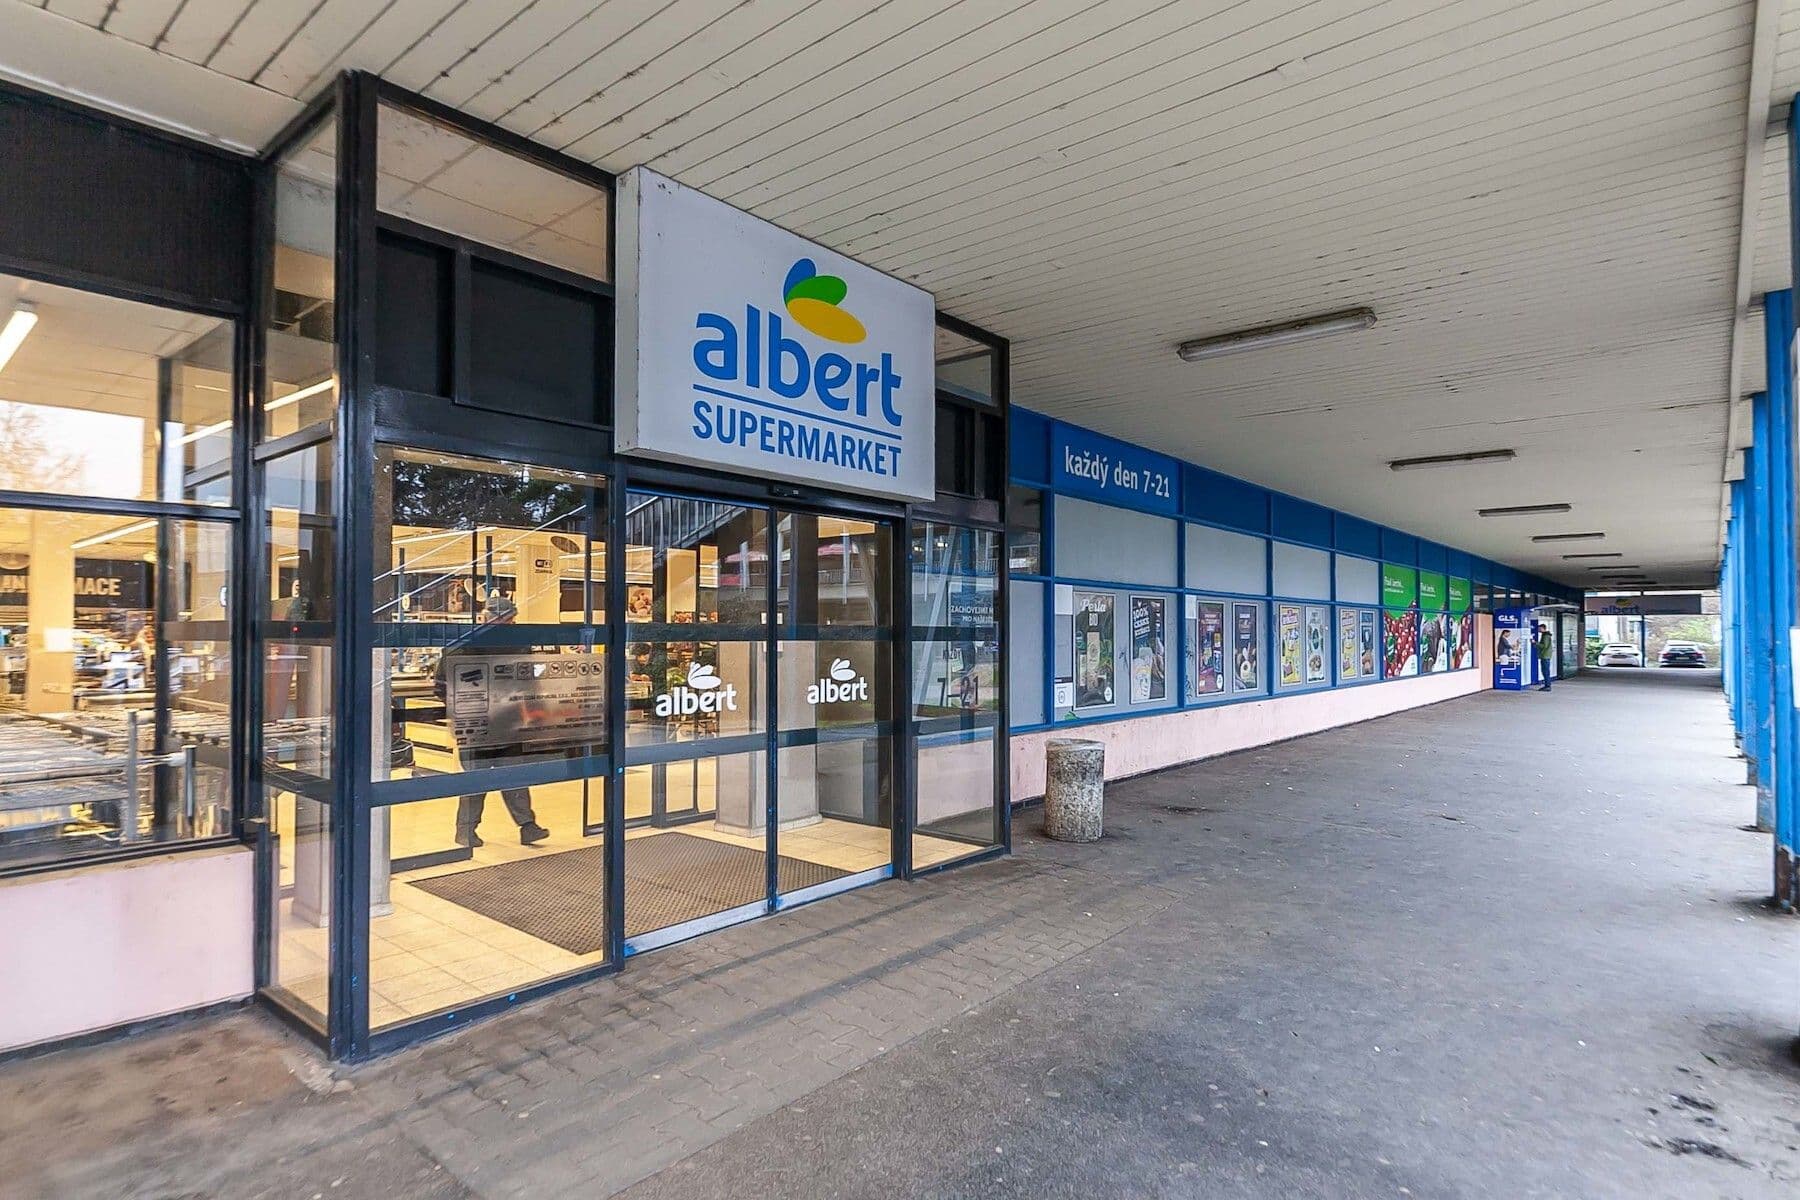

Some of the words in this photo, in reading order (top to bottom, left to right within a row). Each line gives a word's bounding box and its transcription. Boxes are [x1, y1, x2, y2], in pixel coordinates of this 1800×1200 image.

[693, 303, 903, 427] albert
[693, 400, 902, 478] SUPERMARKET
[1065, 445, 1109, 489] každý
[1114, 460, 1138, 490] den
[1143, 470, 1170, 498] 7-21
[1498, 614, 1516, 622] GLS
[655, 683, 738, 717] albert
[807, 676, 868, 704] albert
